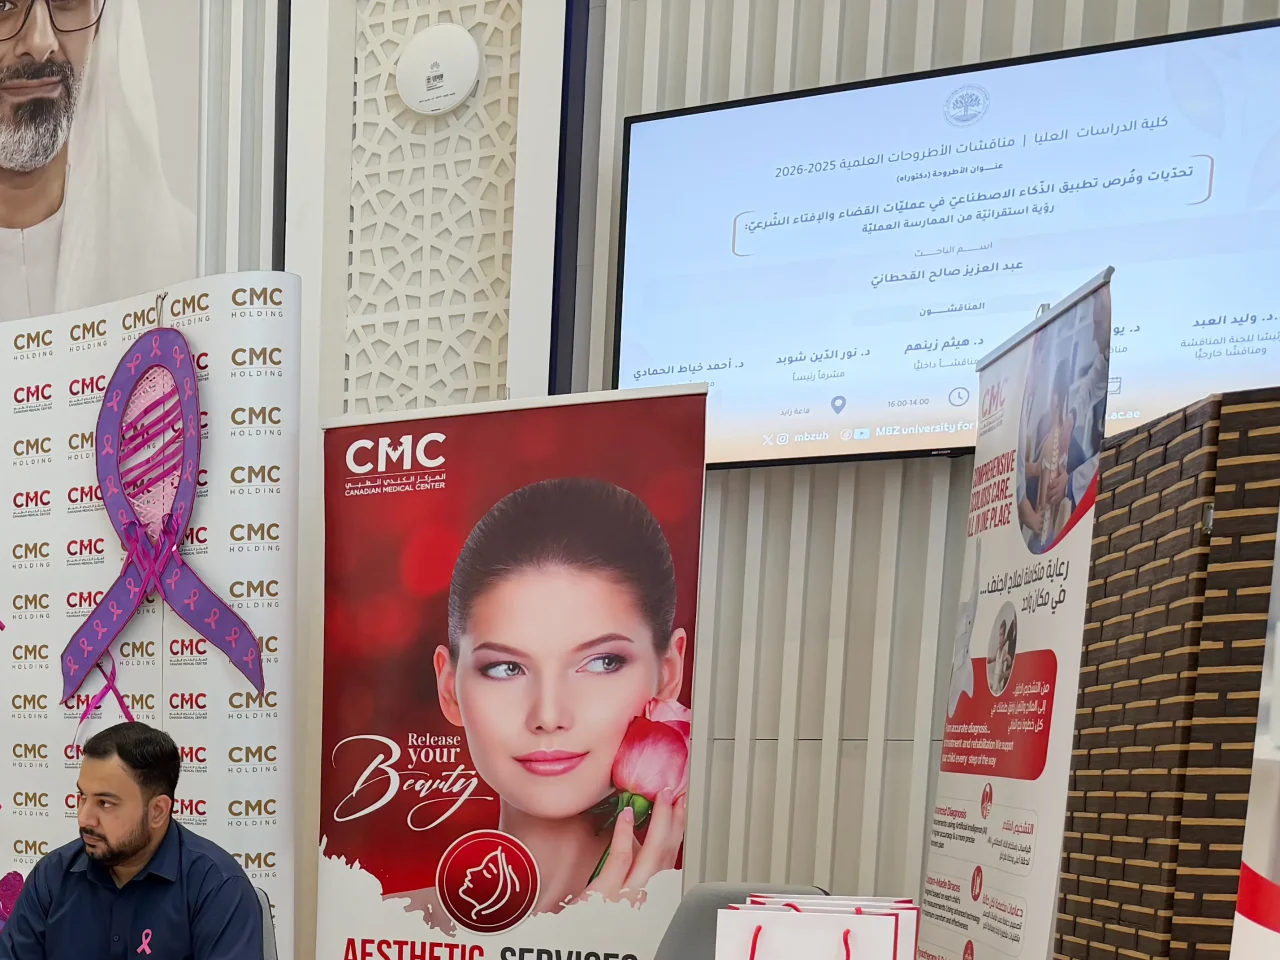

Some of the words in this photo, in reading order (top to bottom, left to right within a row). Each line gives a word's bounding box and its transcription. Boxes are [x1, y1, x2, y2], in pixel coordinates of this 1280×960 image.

[1076, 120, 1137, 138] الدراسات
[1141, 116, 1168, 130] كلية
[955, 136, 1015, 154] مناقشات
[1034, 129, 1068, 146] العليا
[888, 144, 951, 163] الأطروحات
[839, 154, 883, 171] العلمية
[932, 166, 968, 178] الأطروحة
[1058, 177, 1098, 194] تطبيق
[838, 204, 879, 221] القضاء
[929, 197, 945, 215] في
[903, 214, 954, 229] الممارسة
[963, 262, 999, 277] العزيز
[1002, 260, 1024, 271] عبد
[928, 267, 961, 282] صالح
[231, 287, 283, 306] CMC
[231, 310, 283, 318] HOLDING
[904, 340, 938, 354] زينهم
[942, 336, 969, 351] هيثم
[840, 348, 857, 361] نور
[677, 361, 704, 374] خياط
[706, 358, 732, 372] أحمد
[633, 365, 674, 381] الحمادي
[876, 425, 900, 436] MBZ
[902, 421, 955, 435] university
[957, 421, 974, 431] for
[346, 433, 446, 473] CMC
[345, 479, 381, 489] الطبي
[383, 476, 414, 486] الكندي
[417, 473, 446, 483] المركز
[345, 486, 381, 496] CANADIAN
[383, 484, 413, 493] MEDICAL
[415, 482, 445, 490] CENTER
[407, 732, 461, 746] Release
[229, 745, 278, 764] CMC
[407, 746, 461, 769] your
[228, 766, 277, 774] HOLDING
[331, 734, 494, 831] Beauty
